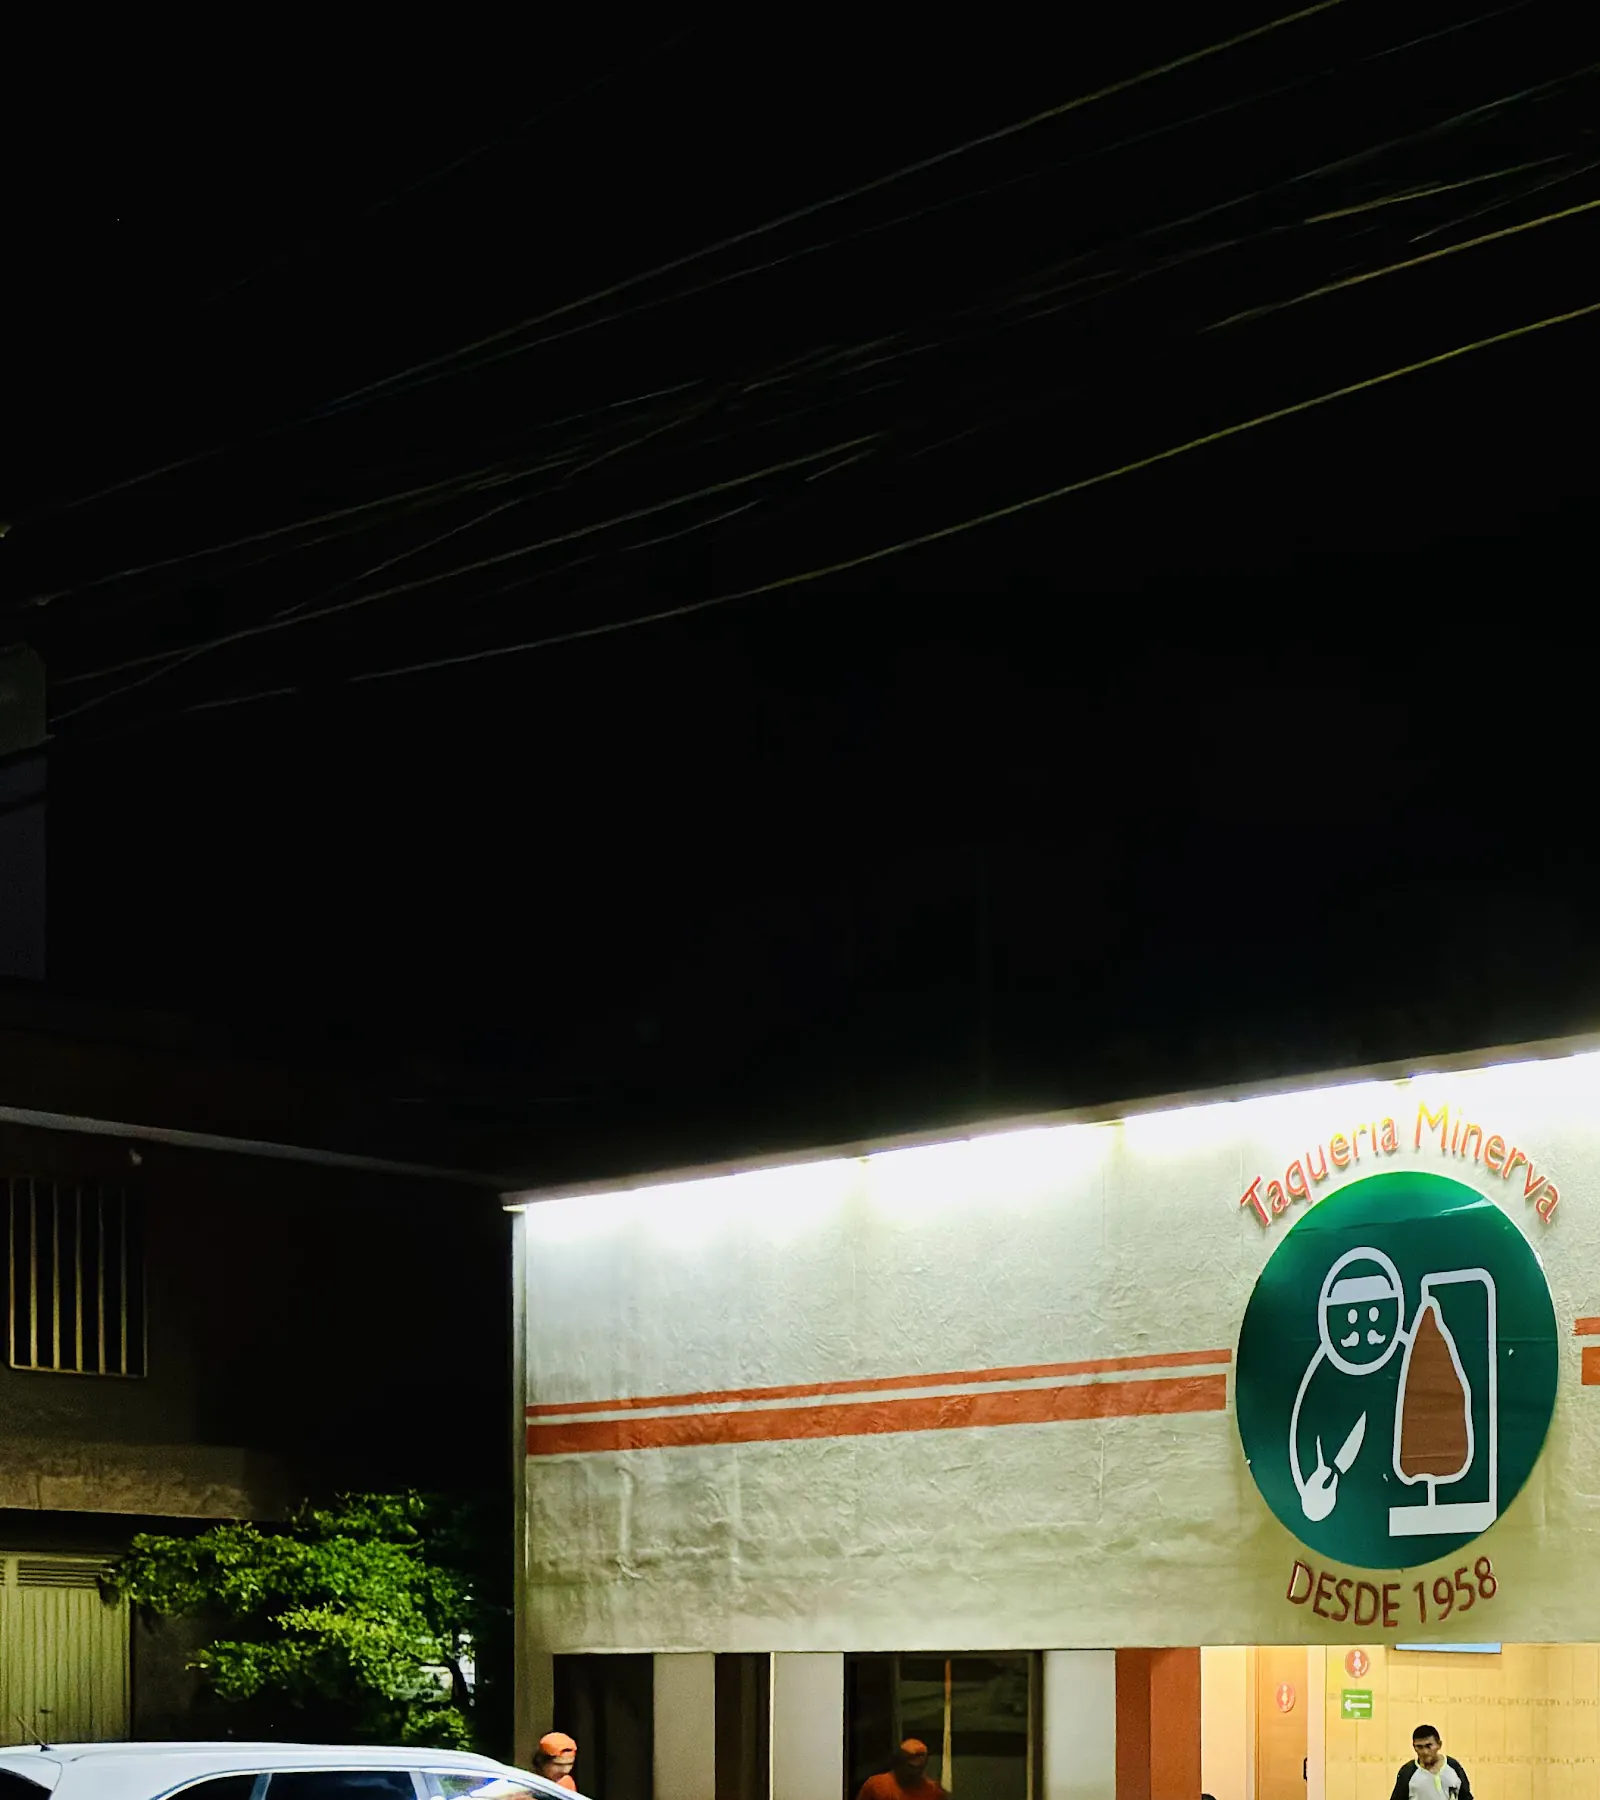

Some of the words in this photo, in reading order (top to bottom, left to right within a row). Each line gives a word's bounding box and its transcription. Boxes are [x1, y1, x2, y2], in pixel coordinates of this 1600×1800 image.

[1414, 1102, 1562, 1225] Minerva
[1286, 1560, 1401, 1628] DESDE
[1412, 1556, 1499, 1624] 1958
